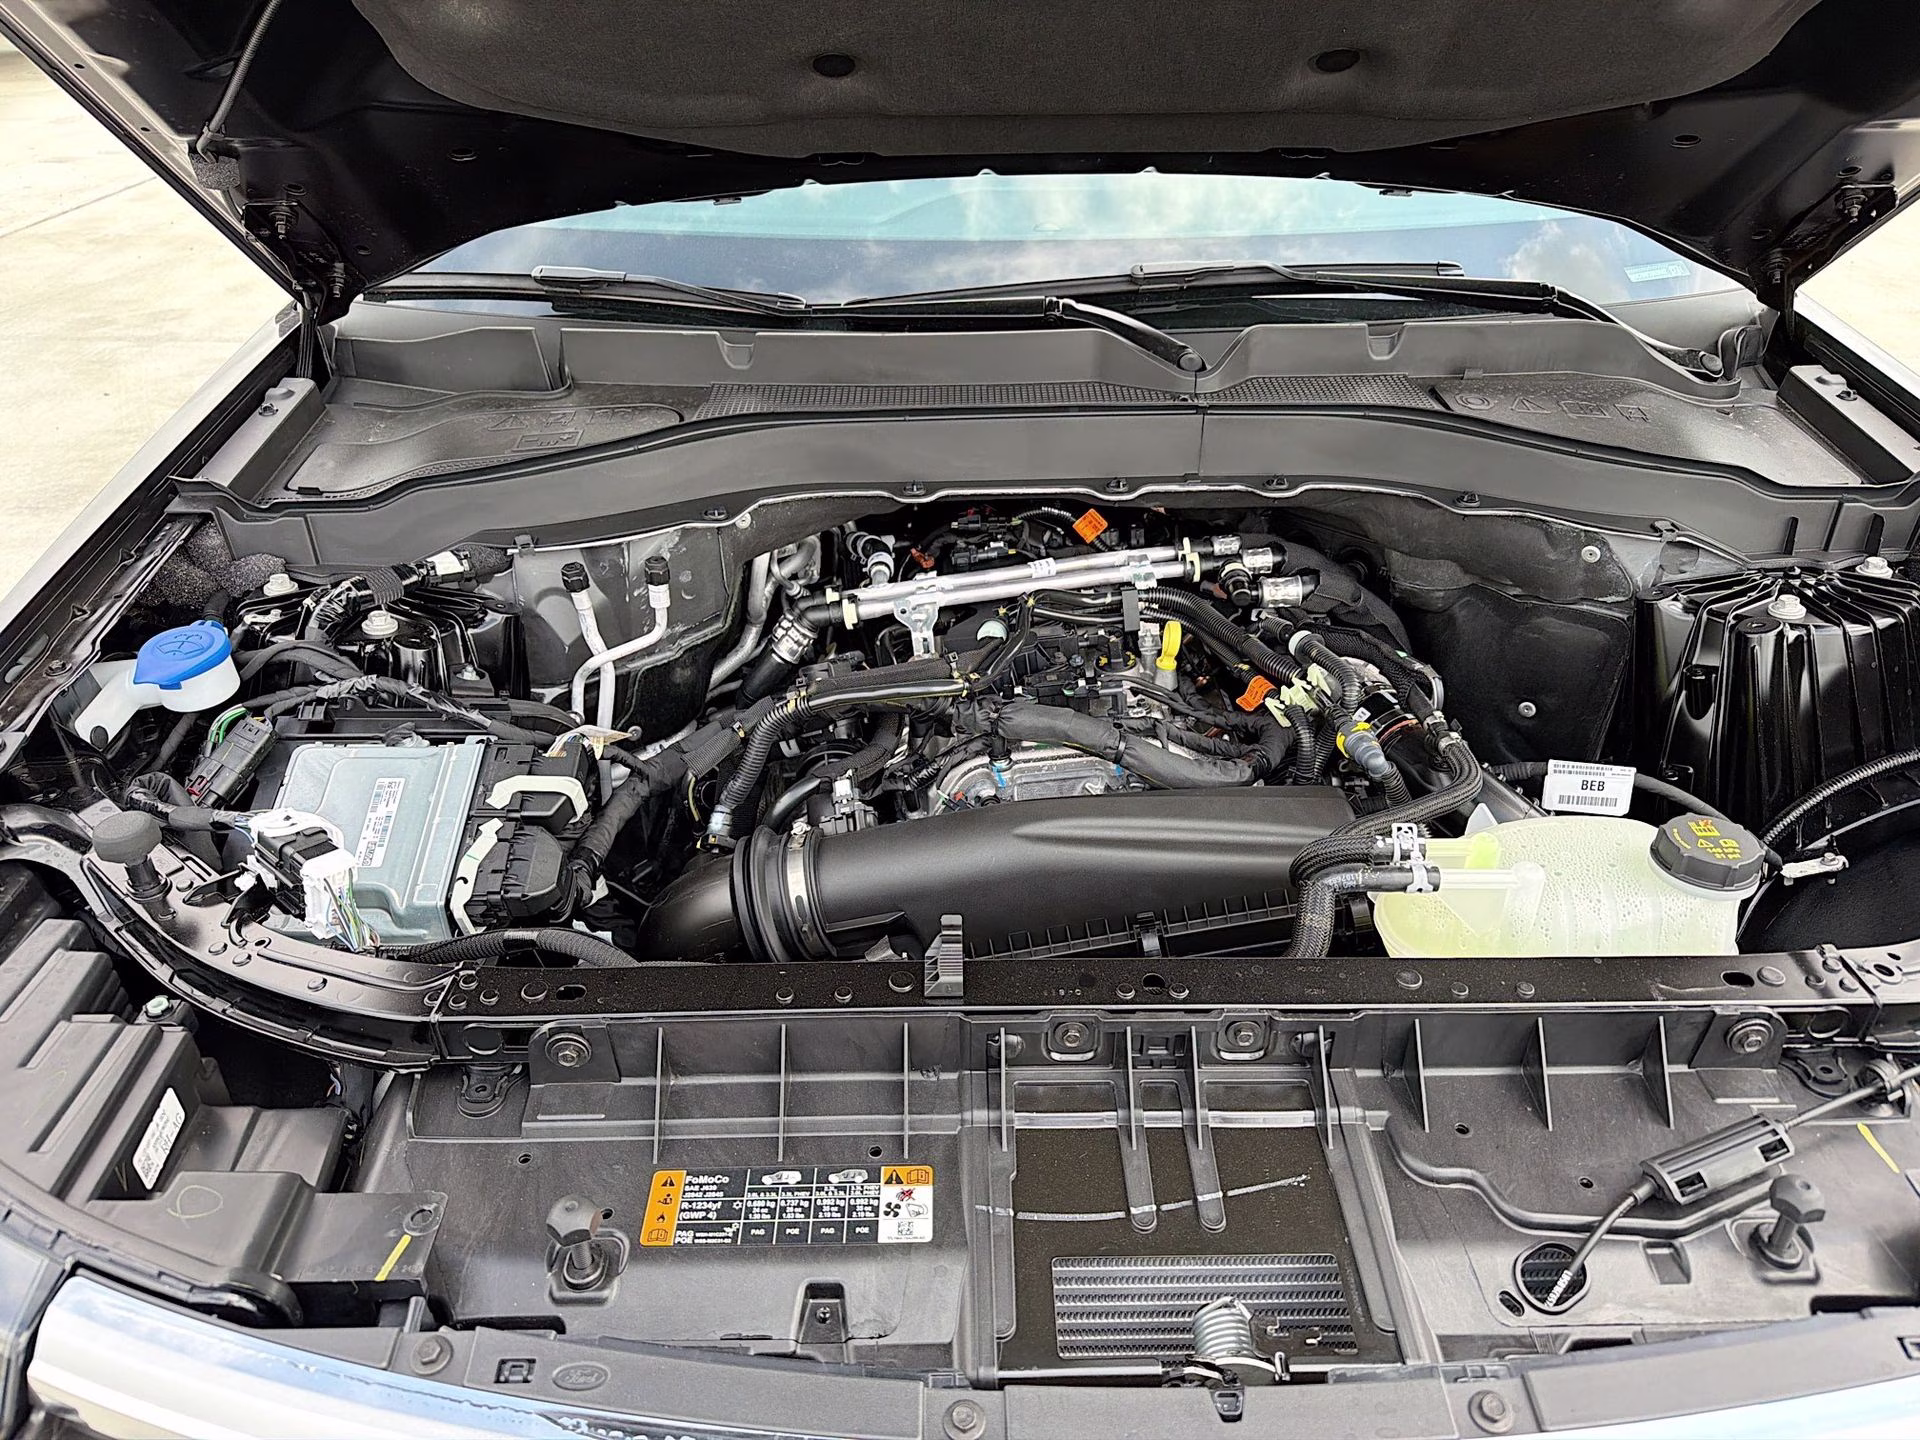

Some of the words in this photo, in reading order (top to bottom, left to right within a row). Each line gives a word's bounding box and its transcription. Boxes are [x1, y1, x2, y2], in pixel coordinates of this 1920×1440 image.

[1581, 779, 1605, 791] BEB
[685, 1175, 730, 1184] FoMoCo
[680, 1201, 722, 1211] R-1234yf
[766, 1200, 776, 1208] kg
[799, 1199, 809, 1208] kg
[835, 1198, 845, 1207] kg
[869, 1198, 879, 1206] kg
[679, 1211, 706, 1221] (GWP
[707, 1211, 717, 1221] 4)
